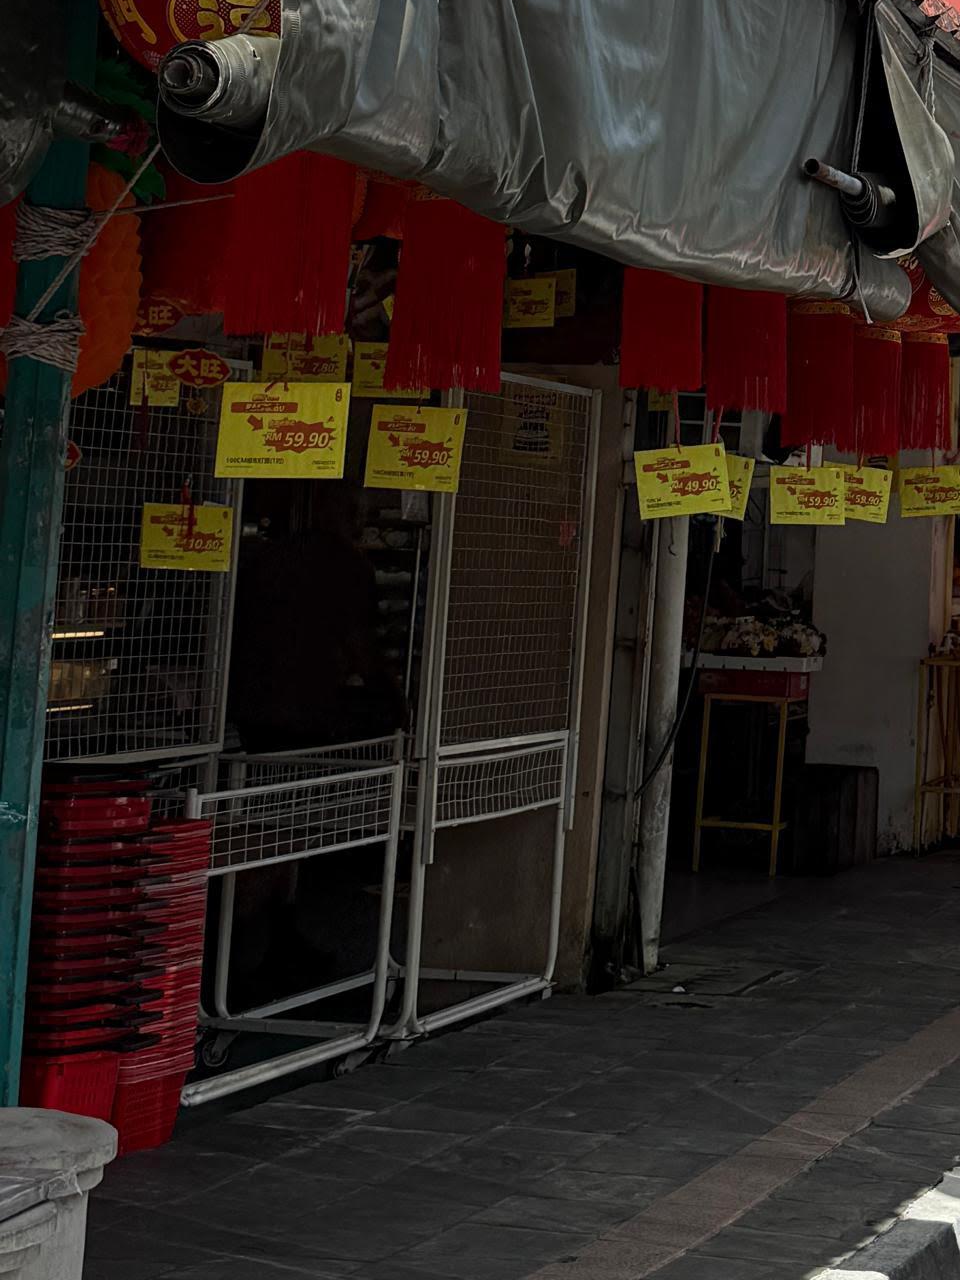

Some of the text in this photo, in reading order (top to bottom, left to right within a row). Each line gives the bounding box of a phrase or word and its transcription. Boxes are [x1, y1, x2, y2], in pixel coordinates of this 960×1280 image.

[174, 354, 224, 380] 大旺
[283, 432, 330, 448] 59.90
[413, 449, 448, 465] 59.90
[685, 479, 717, 493] 49.90
